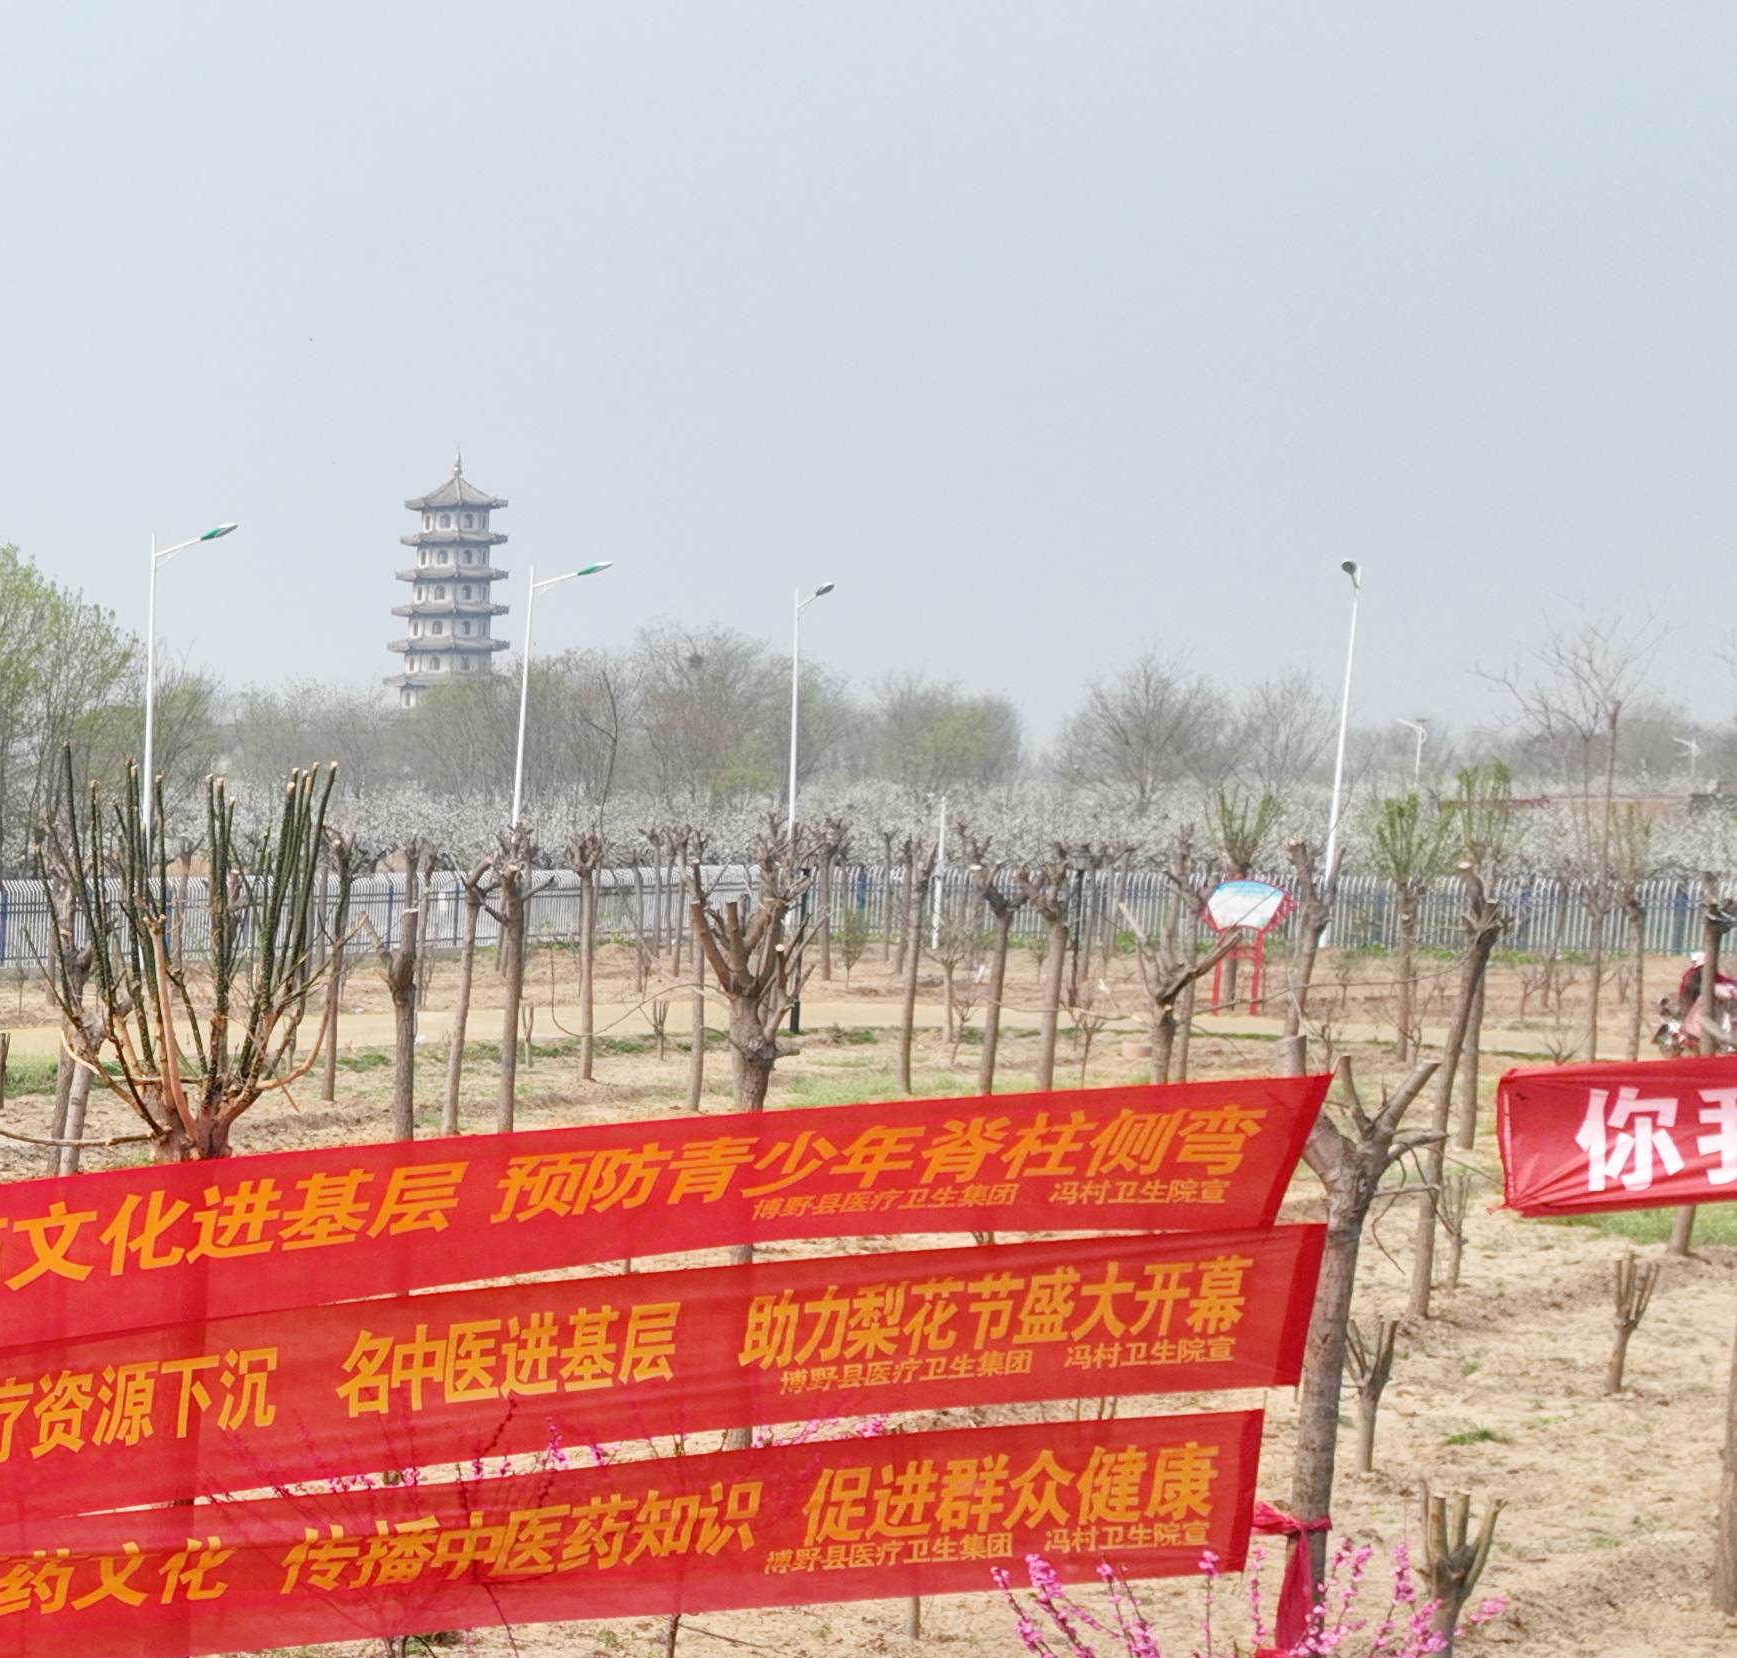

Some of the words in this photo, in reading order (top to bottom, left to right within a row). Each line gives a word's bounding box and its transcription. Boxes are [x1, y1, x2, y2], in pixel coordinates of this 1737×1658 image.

[491, 1106, 1266, 1223] 预防青少年脊柱侧弯
[753, 1183, 1018, 1222] 博野县医疗卫生集团
[1049, 1179, 1229, 1206] 冯村卫生院宣
[336, 1301, 680, 1418] 名中医进基层
[738, 1255, 1252, 1370] 助力梨花节盛大开幕
[780, 1347, 1032, 1394] 博野县医疗卫生集团
[1064, 1337, 1235, 1371] 冯村卫生院宣
[282, 1480, 764, 1592] 传播中医药知识
[804, 1441, 1218, 1545] 促进群众健康
[765, 1533, 1012, 1574] 博野县医疗卫生集团
[1045, 1519, 1210, 1552] 冯村卫生院宣
